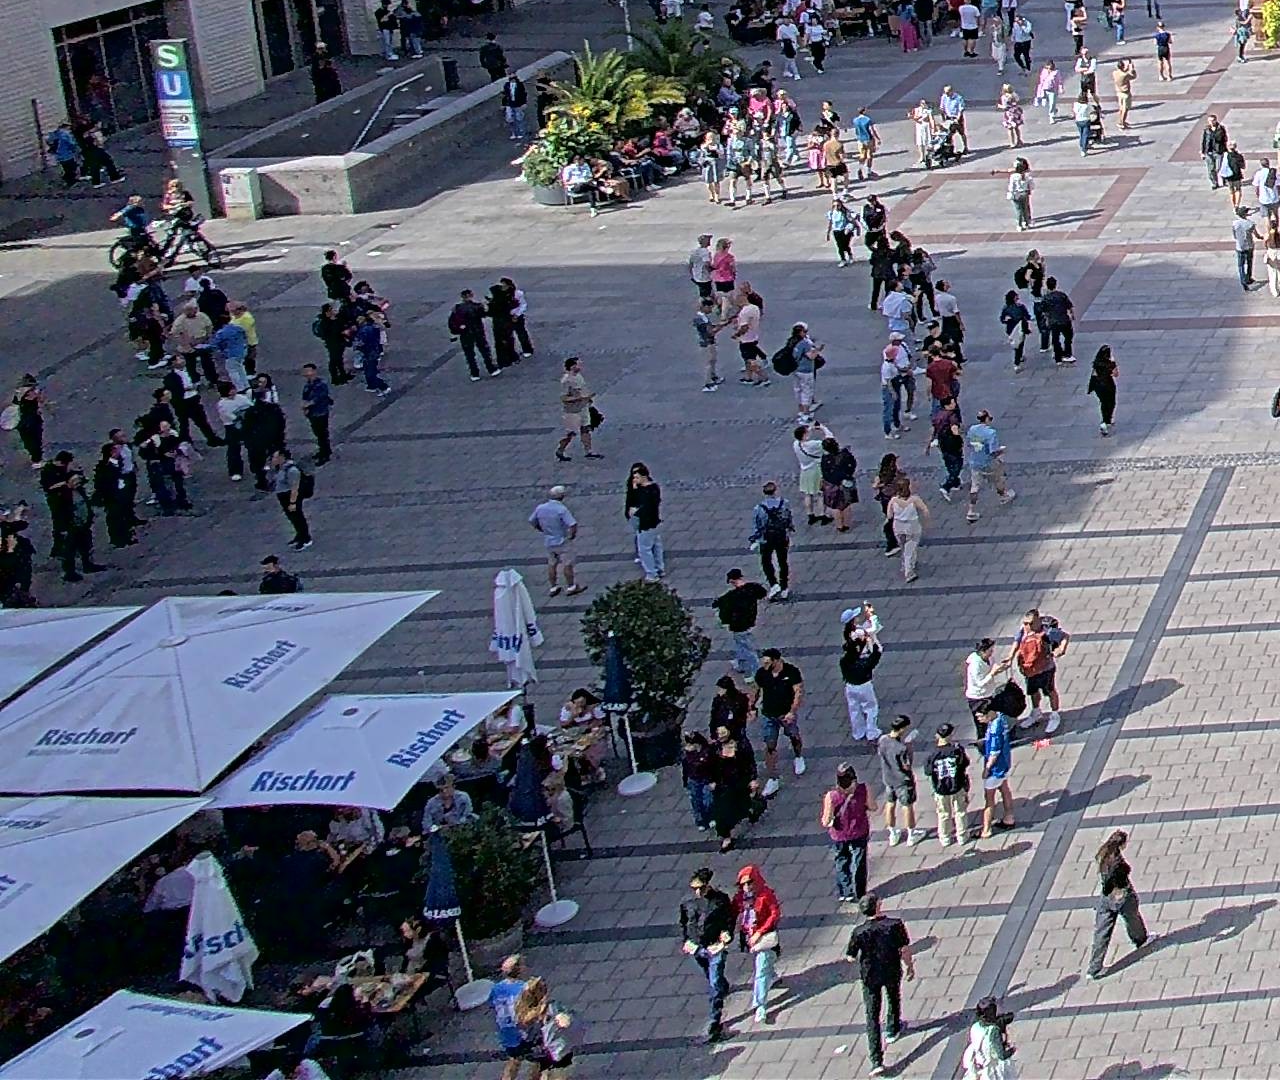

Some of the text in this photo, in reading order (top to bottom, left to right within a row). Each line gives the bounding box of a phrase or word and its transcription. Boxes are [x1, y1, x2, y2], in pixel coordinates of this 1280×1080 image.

[158, 45, 179, 68] S
[163, 74, 182, 96] U
[222, 640, 298, 689] Rischart
[36, 727, 138, 746] Rischart
[386, 708, 466, 769] Rischart
[250, 769, 356, 792] Rischart
